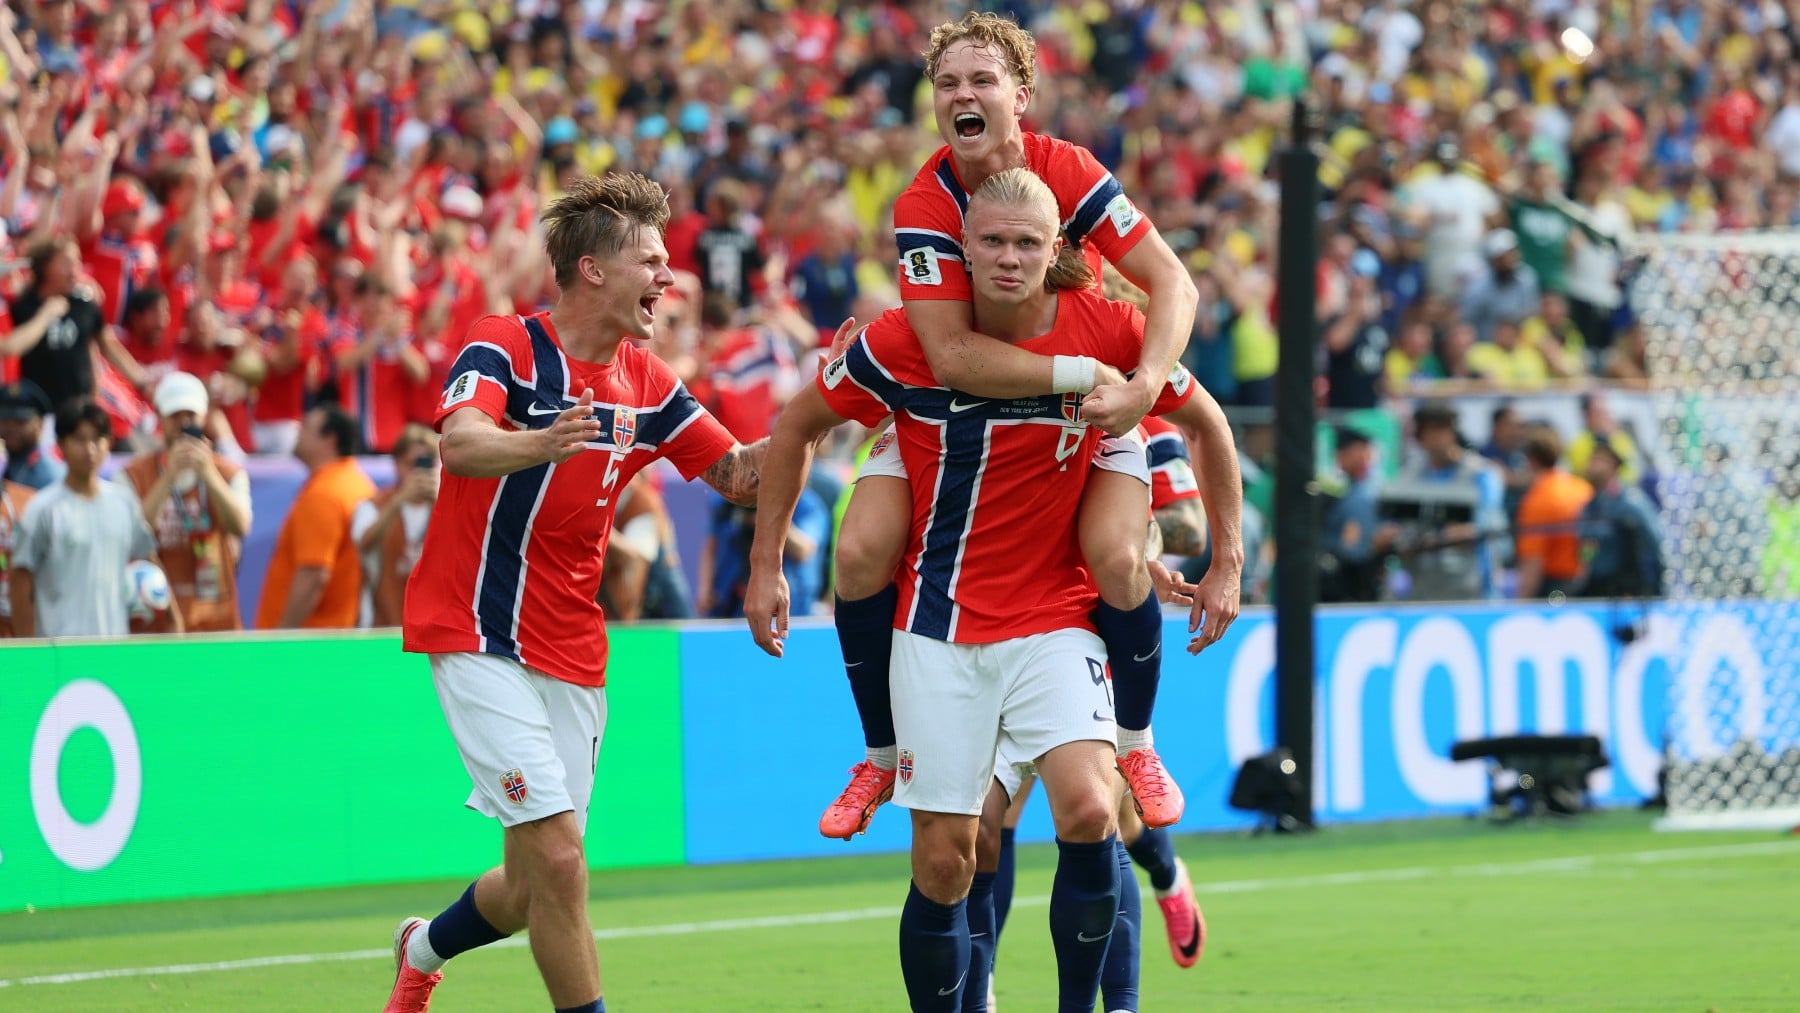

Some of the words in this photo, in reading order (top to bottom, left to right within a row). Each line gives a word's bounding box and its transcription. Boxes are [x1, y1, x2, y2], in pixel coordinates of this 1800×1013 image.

[1055, 427, 1086, 472] 9
[595, 452, 626, 507] 5
[1085, 656, 1112, 708] 9
[0, 677, 143, 872] O
